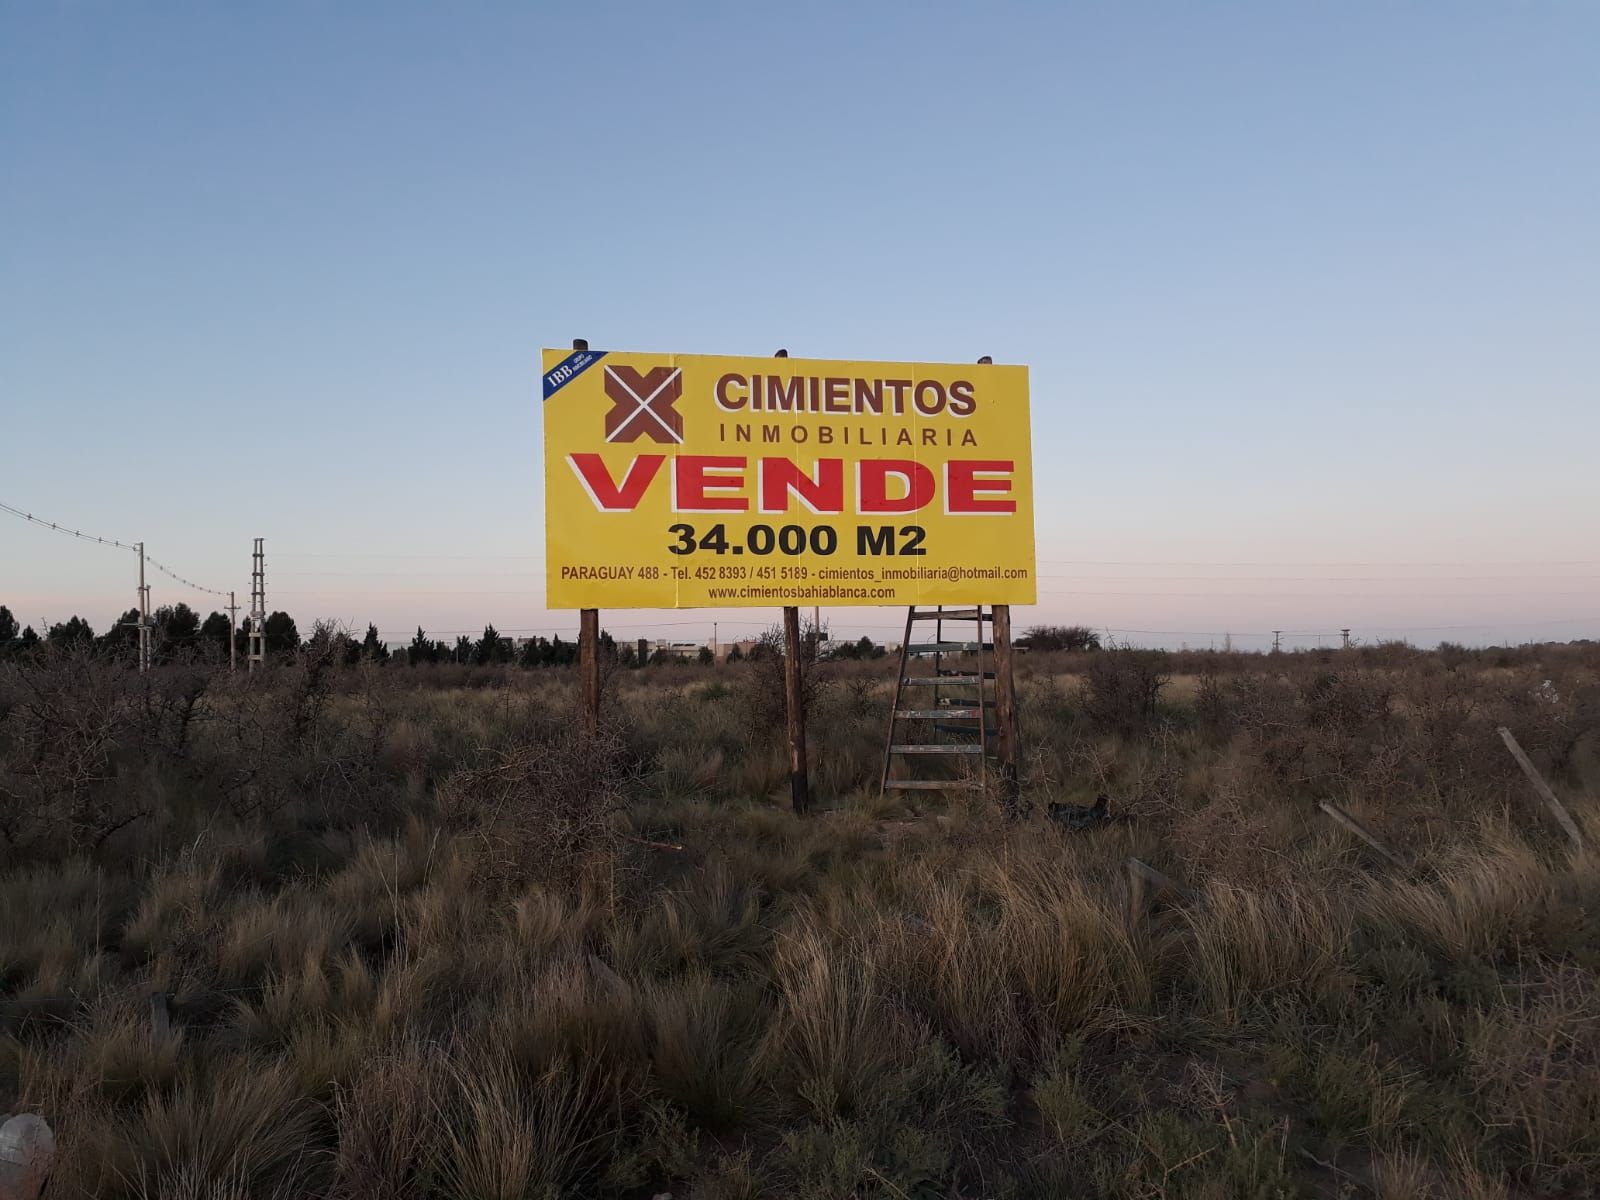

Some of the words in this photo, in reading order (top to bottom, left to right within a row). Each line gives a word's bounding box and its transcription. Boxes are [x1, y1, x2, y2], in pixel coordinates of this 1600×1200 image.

[547, 365, 573, 387] IBB
[714, 373, 977, 418] CIMIENTOS
[719, 423, 978, 447] INMOBILIARIA
[565, 453, 1017, 515] VENDE
[667, 523, 838, 556] 34.000
[856, 525, 928, 556] M2
[561, 566, 635, 580] PARAGUAY
[638, 566, 659, 580] 488
[670, 566, 692, 580] Tel.
[695, 566, 716, 580] 452
[718, 566, 747, 580] 8393
[756, 566, 777, 580] 451
[780, 566, 808, 580] 5189
[818, 566, 1028, 583] cimientos_inmobiliaria@hotmail.com
[708, 584, 896, 599] www.cimientosbahiablanca.com
